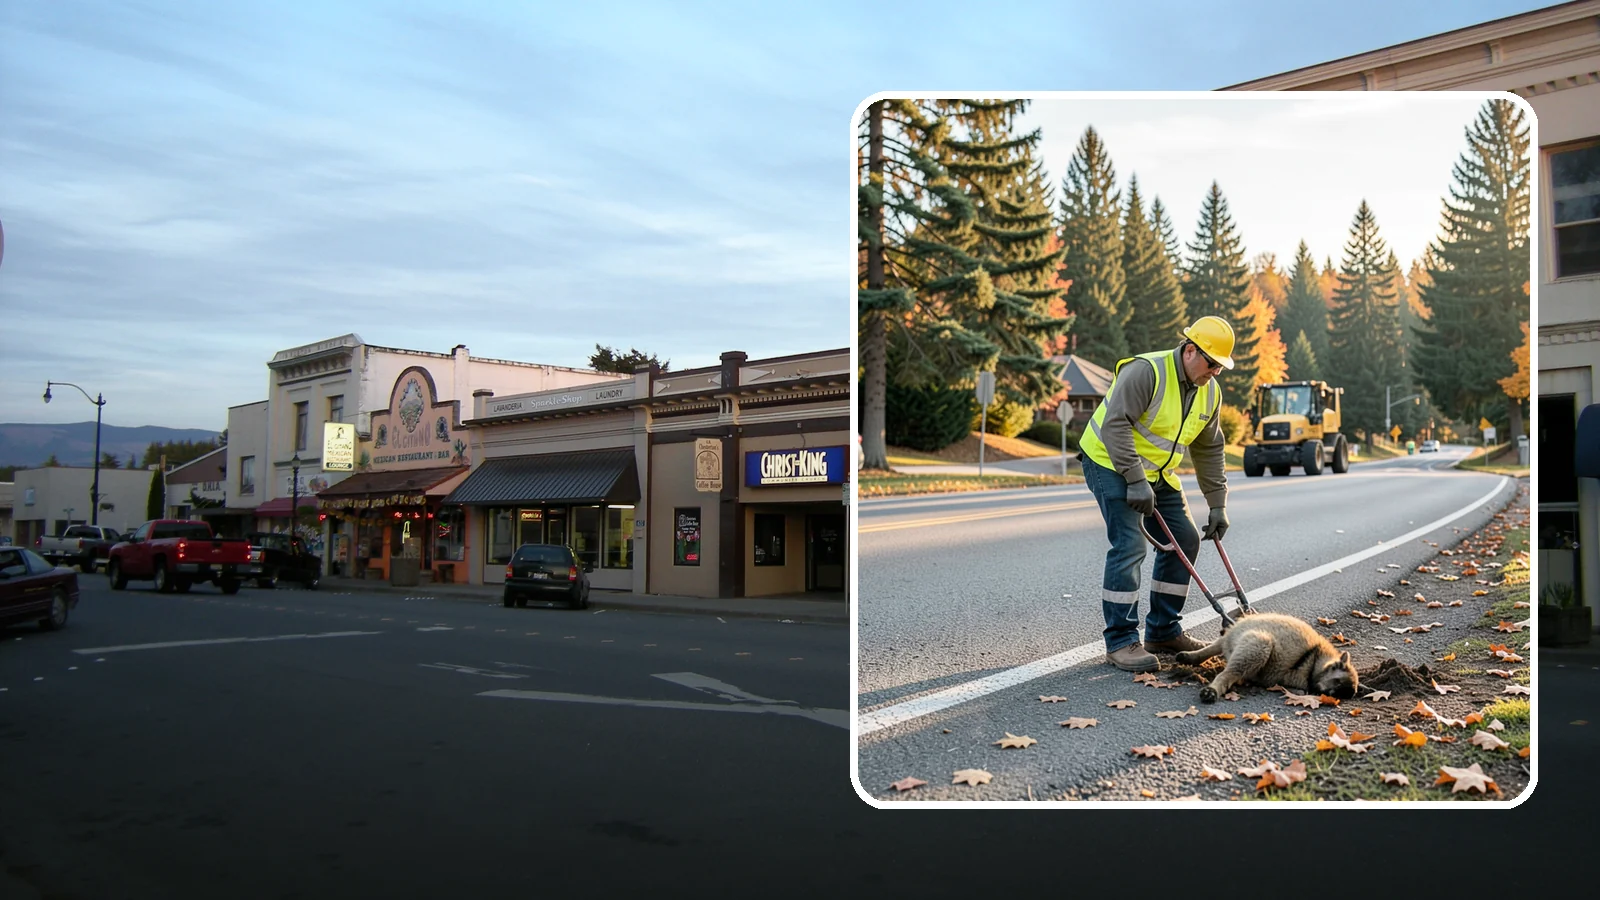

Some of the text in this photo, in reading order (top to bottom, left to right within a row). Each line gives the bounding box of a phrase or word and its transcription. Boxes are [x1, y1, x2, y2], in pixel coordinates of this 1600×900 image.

[561, 394, 583, 407] Shop
[595, 388, 624, 400] LAUNDRY
[493, 401, 523, 413] LAVANDERIA
[373, 450, 450, 465] MEXICAN RESTAURANT BAR
[760, 449, 827, 478] CHRIST KING
